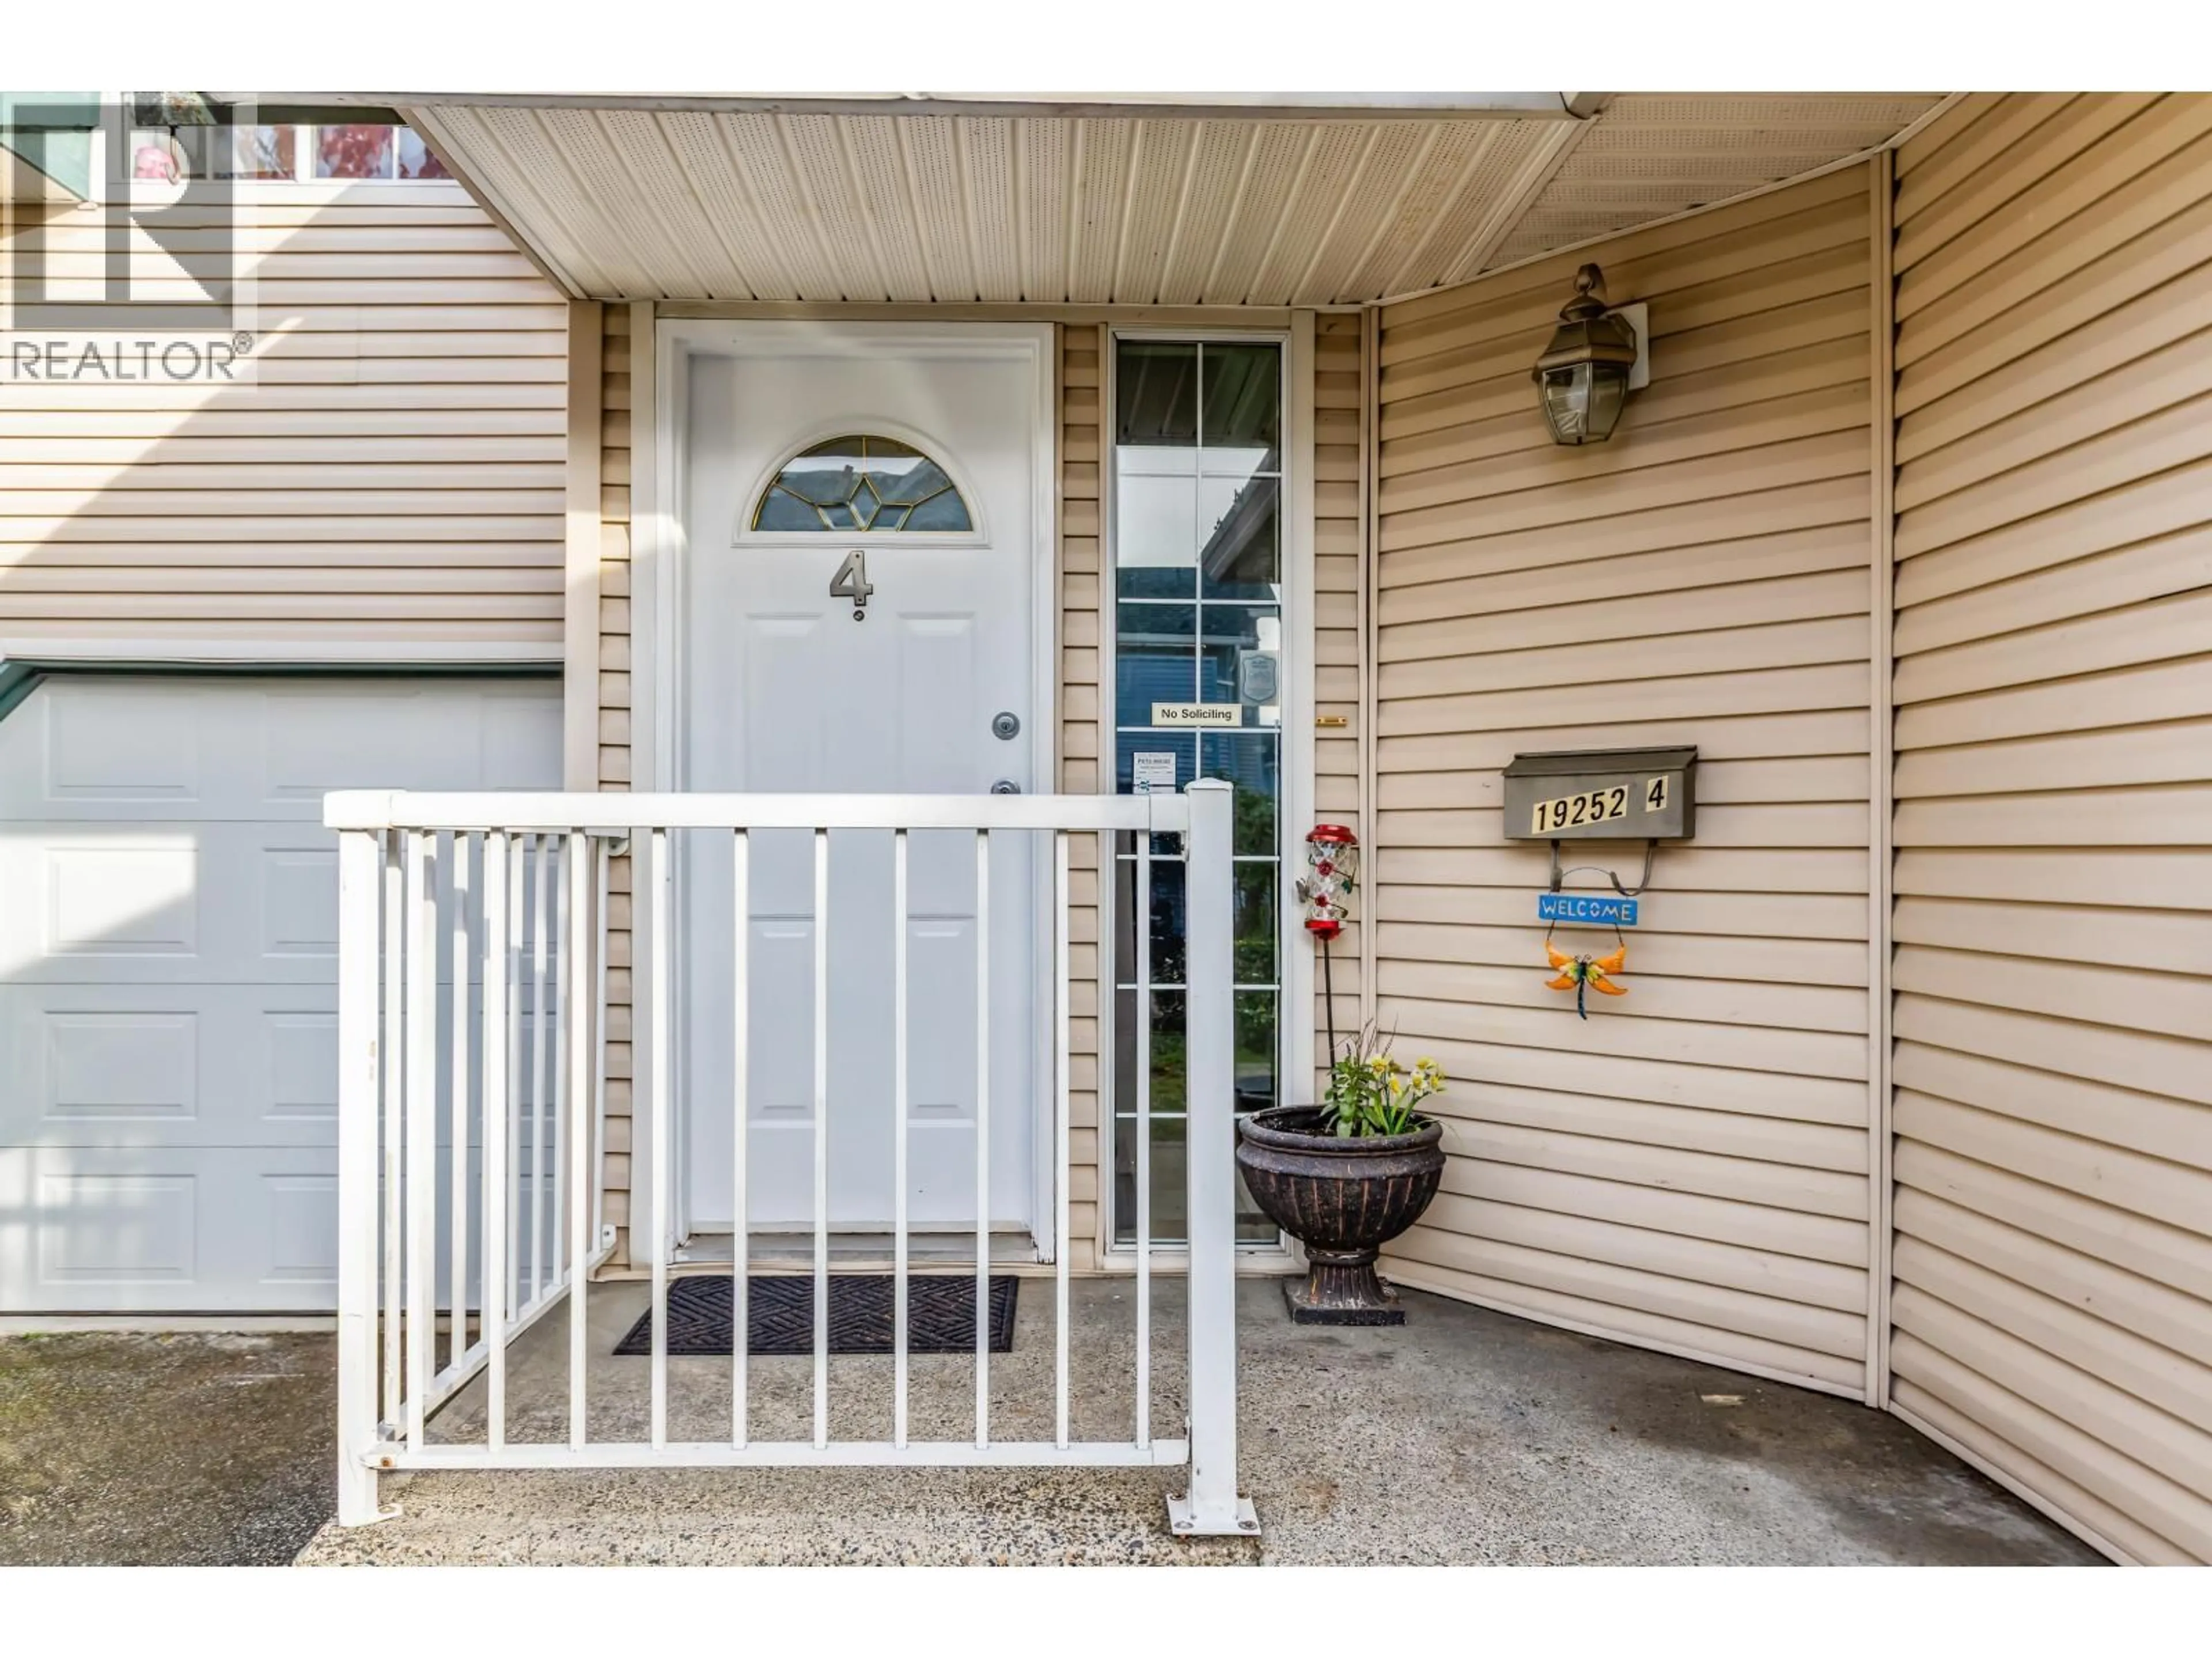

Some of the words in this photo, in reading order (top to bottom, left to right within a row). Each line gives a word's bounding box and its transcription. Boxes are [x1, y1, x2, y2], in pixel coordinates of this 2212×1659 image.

[830, 550, 873, 606] 4
[1161, 709, 1177, 719] No
[1182, 709, 1232, 721] Soliciting
[1537, 788, 1626, 831] 19252
[1648, 779, 1664, 808] 4
[1542, 900, 1632, 921] WELCOME
